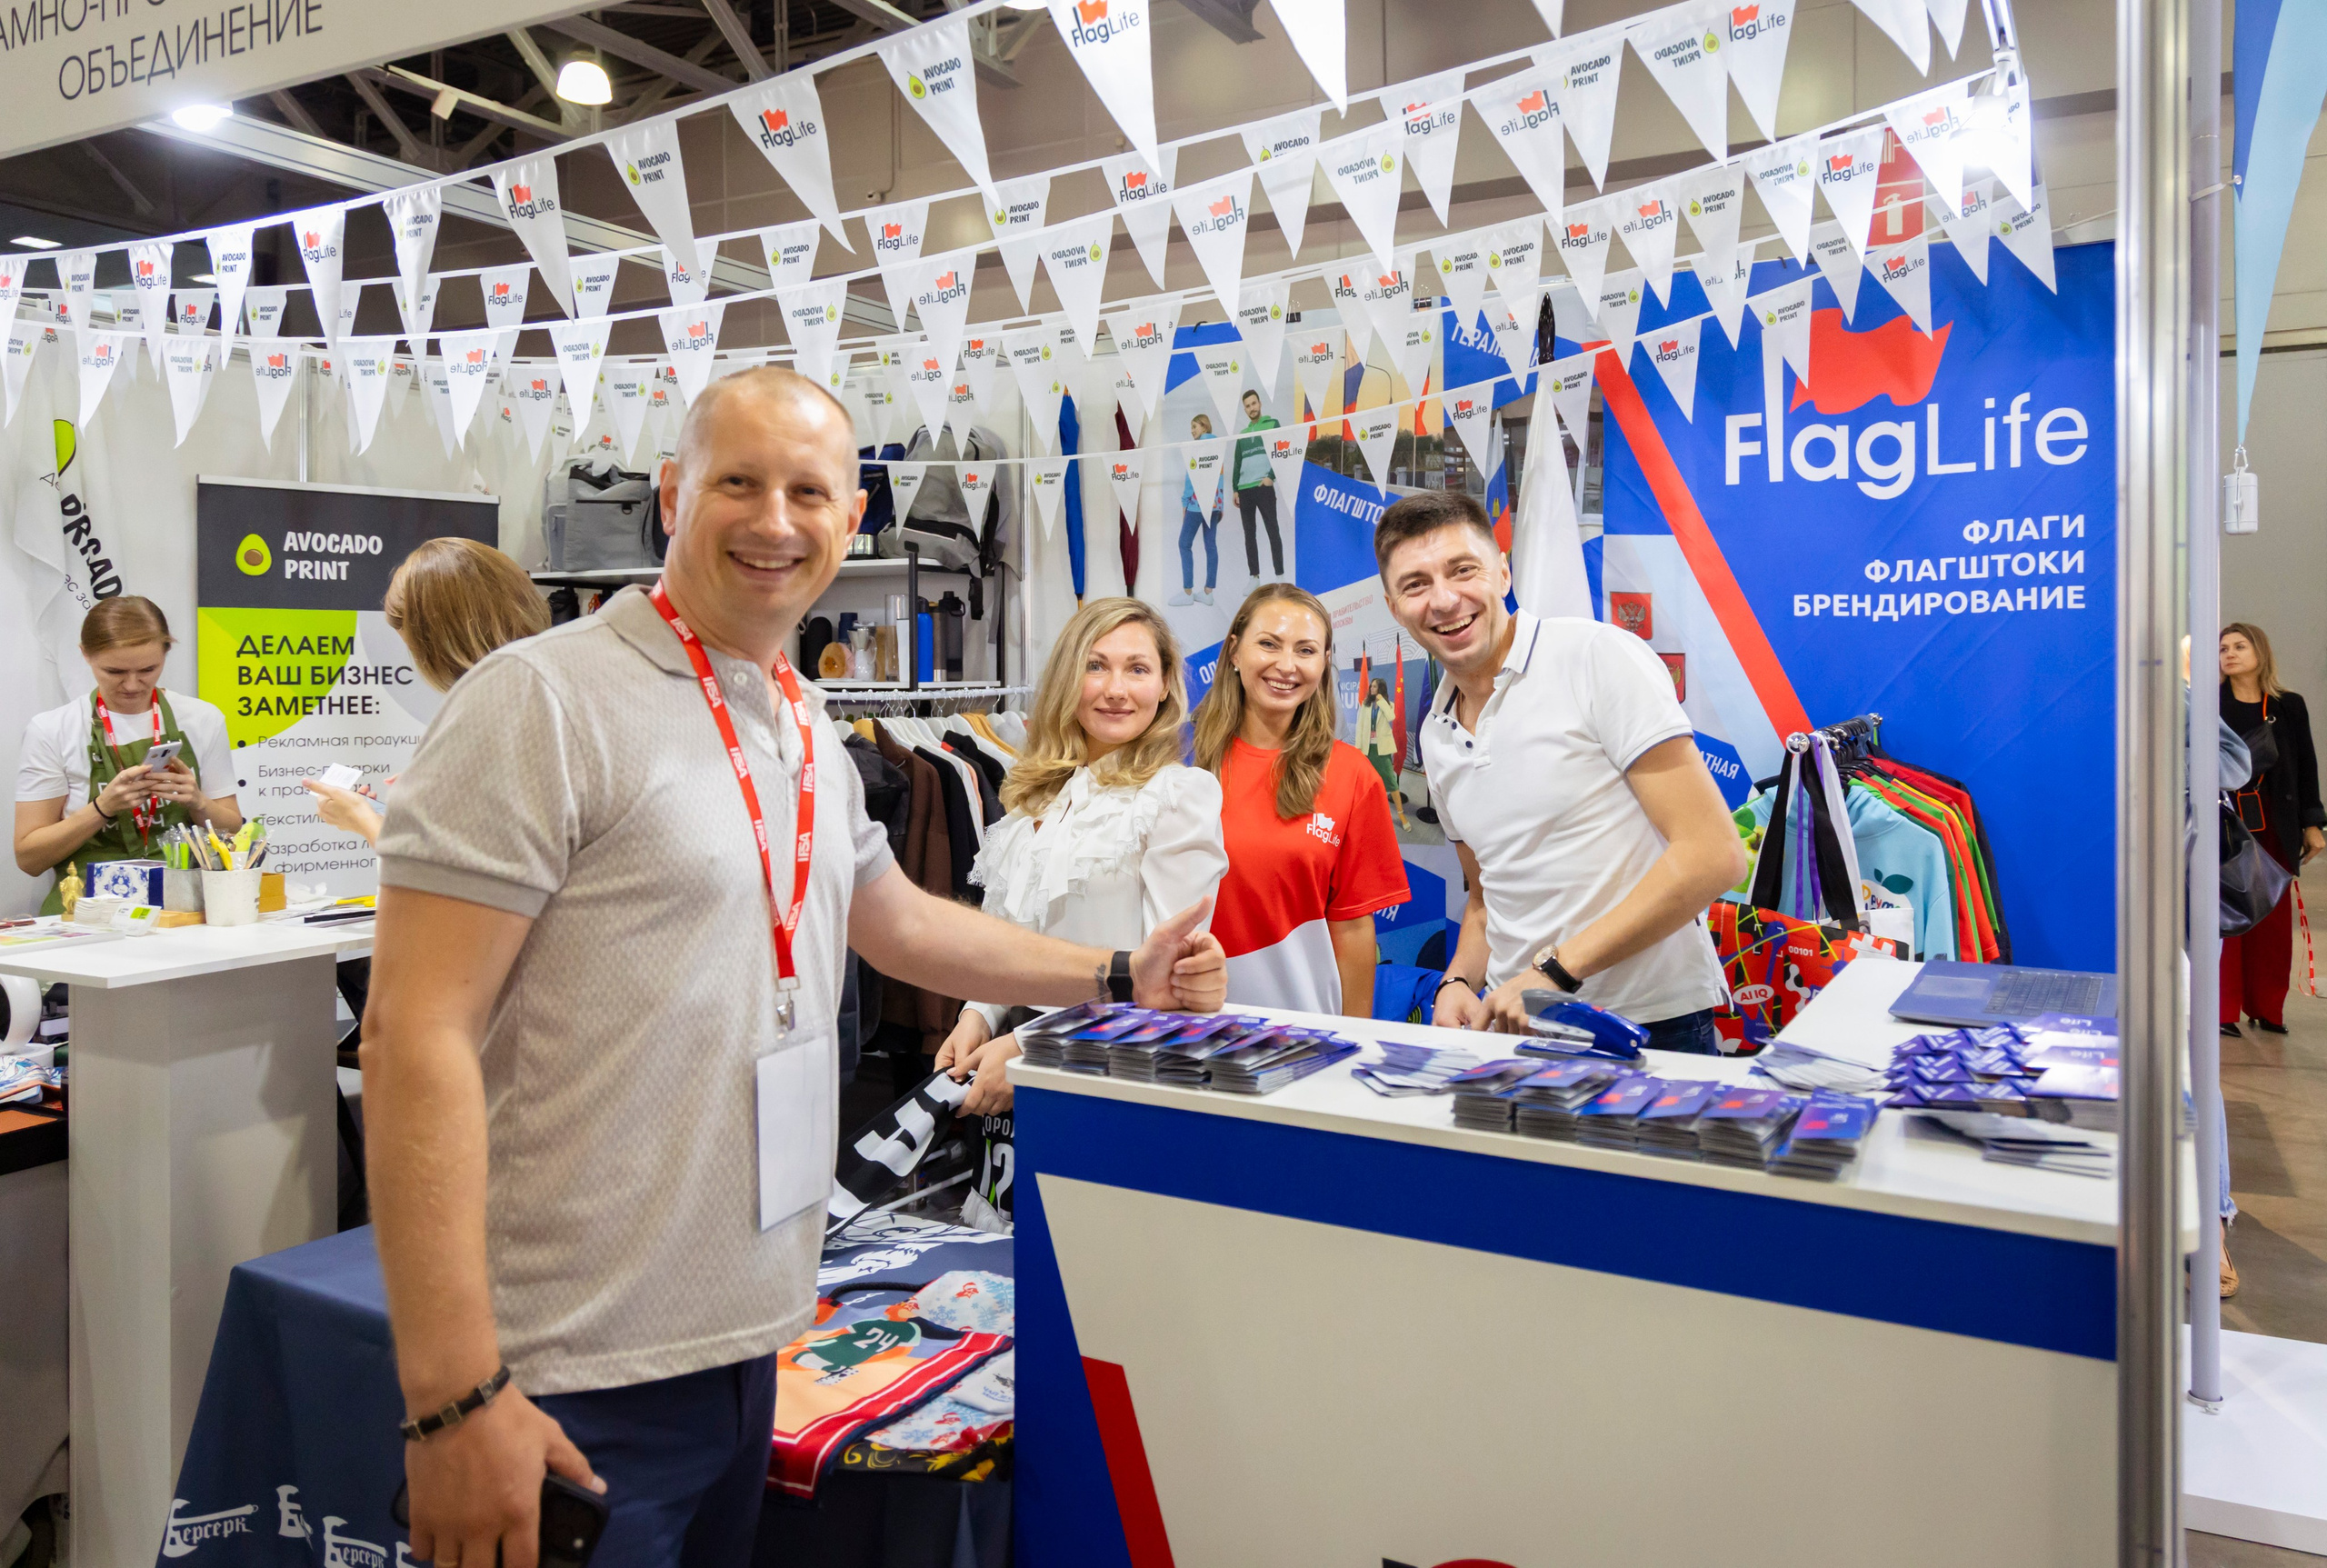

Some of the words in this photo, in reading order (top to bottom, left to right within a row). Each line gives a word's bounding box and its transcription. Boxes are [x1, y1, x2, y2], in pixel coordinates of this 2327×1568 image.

[59, 0, 323, 100] ОБЪЕДИНЕНИЕ
[924, 57, 962, 81] AVOCADO
[1571, 55, 1611, 76] AVOCADO
[930, 77, 955, 95] PRINT
[1573, 73, 1599, 89] PRINT
[1273, 136, 1309, 152] AVOCADO
[638, 152, 671, 171] AVOCADO
[643, 169, 665, 184] PRINT
[1703, 189, 1735, 205] AVOCADO
[1009, 201, 1039, 214] AVOCADO
[1704, 202, 1726, 215] PRINT
[1009, 214, 1031, 224] PRINT
[2014, 216, 2035, 231] PRINT
[783, 245, 809, 255] AVOCADO
[1454, 253, 1479, 263] AVOCAD
[1503, 243, 1534, 257] AVOCADO
[783, 255, 800, 265] PRINT
[1455, 263, 1474, 272] PRINT
[1504, 255, 1525, 266] PRINT
[1777, 301, 1805, 315] AVOCADO
[1780, 311, 1798, 323] PRINT
[1563, 371, 1587, 384] AVOCADO
[1564, 381, 1581, 391] PRINT
[1369, 424, 1392, 433] AVOCADO
[1370, 431, 1384, 440] PRINT
[1313, 484, 1386, 524] ФЛАГШТО
[1962, 514, 2085, 544] ФЛАГИ
[284, 532, 383, 555] AVOCADO
[285, 559, 350, 580] PRINT
[1864, 550, 2084, 583] ФЛАГШТОКИ
[1793, 585, 2086, 622] БРЕНДИРОВАНИЕ
[236, 634, 355, 659] ДЕЛАЕМ
[237, 666, 301, 685] ВАШ
[311, 666, 414, 685] БИЗНЕС
[703, 676, 724, 708] IFSA
[237, 695, 380, 716] ЗАМЕТНЕЕ:
[258, 735, 349, 749] Рекламная
[730, 746, 749, 779] IFSA
[802, 764, 814, 793] IFSA
[754, 819, 768, 853] IFSA
[1306, 813, 1340, 847] FlagLife
[265, 838, 357, 856] азработка
[797, 832, 812, 862] IFSA
[275, 856, 377, 874] фирменног
[785, 901, 802, 931] IFSA
[1788, 945, 1813, 956] 00101
[1754, 988, 1769, 999] IQ
[854, 1327, 899, 1353] 24
